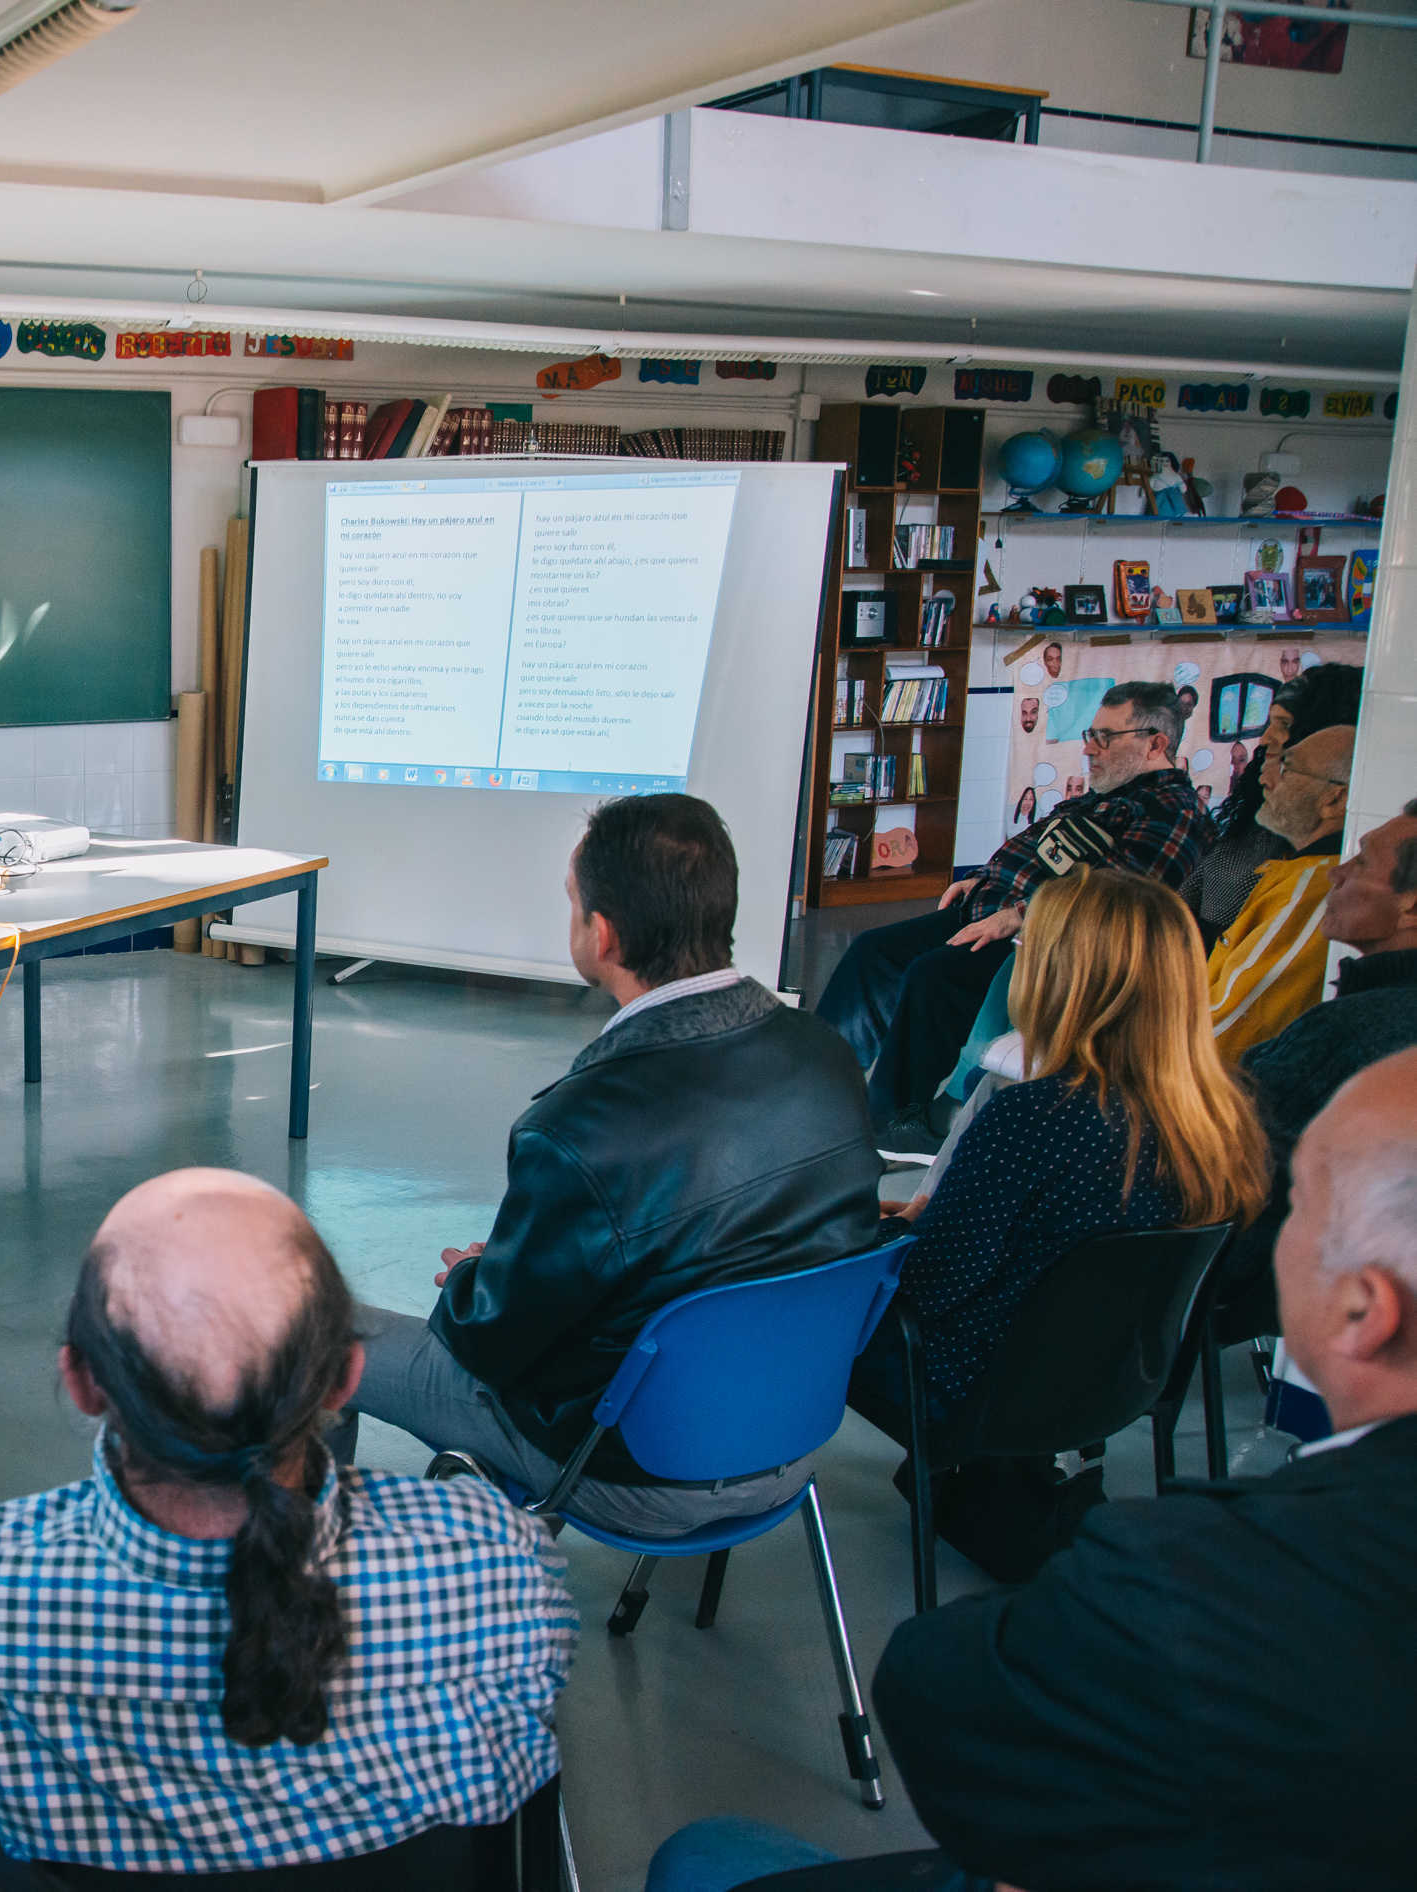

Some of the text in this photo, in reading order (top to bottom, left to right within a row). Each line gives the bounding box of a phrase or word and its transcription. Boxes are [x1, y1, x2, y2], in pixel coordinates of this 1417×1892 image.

[120, 334, 227, 358] ROBERTO
[1119, 384, 1165, 404] PACO
[340, 517, 368, 525] Charles
[371, 517, 409, 525] Bukowski:
[411, 517, 426, 526] Hay
[466, 516, 483, 525] azul
[484, 517, 495, 525] en
[340, 531, 350, 540] mi
